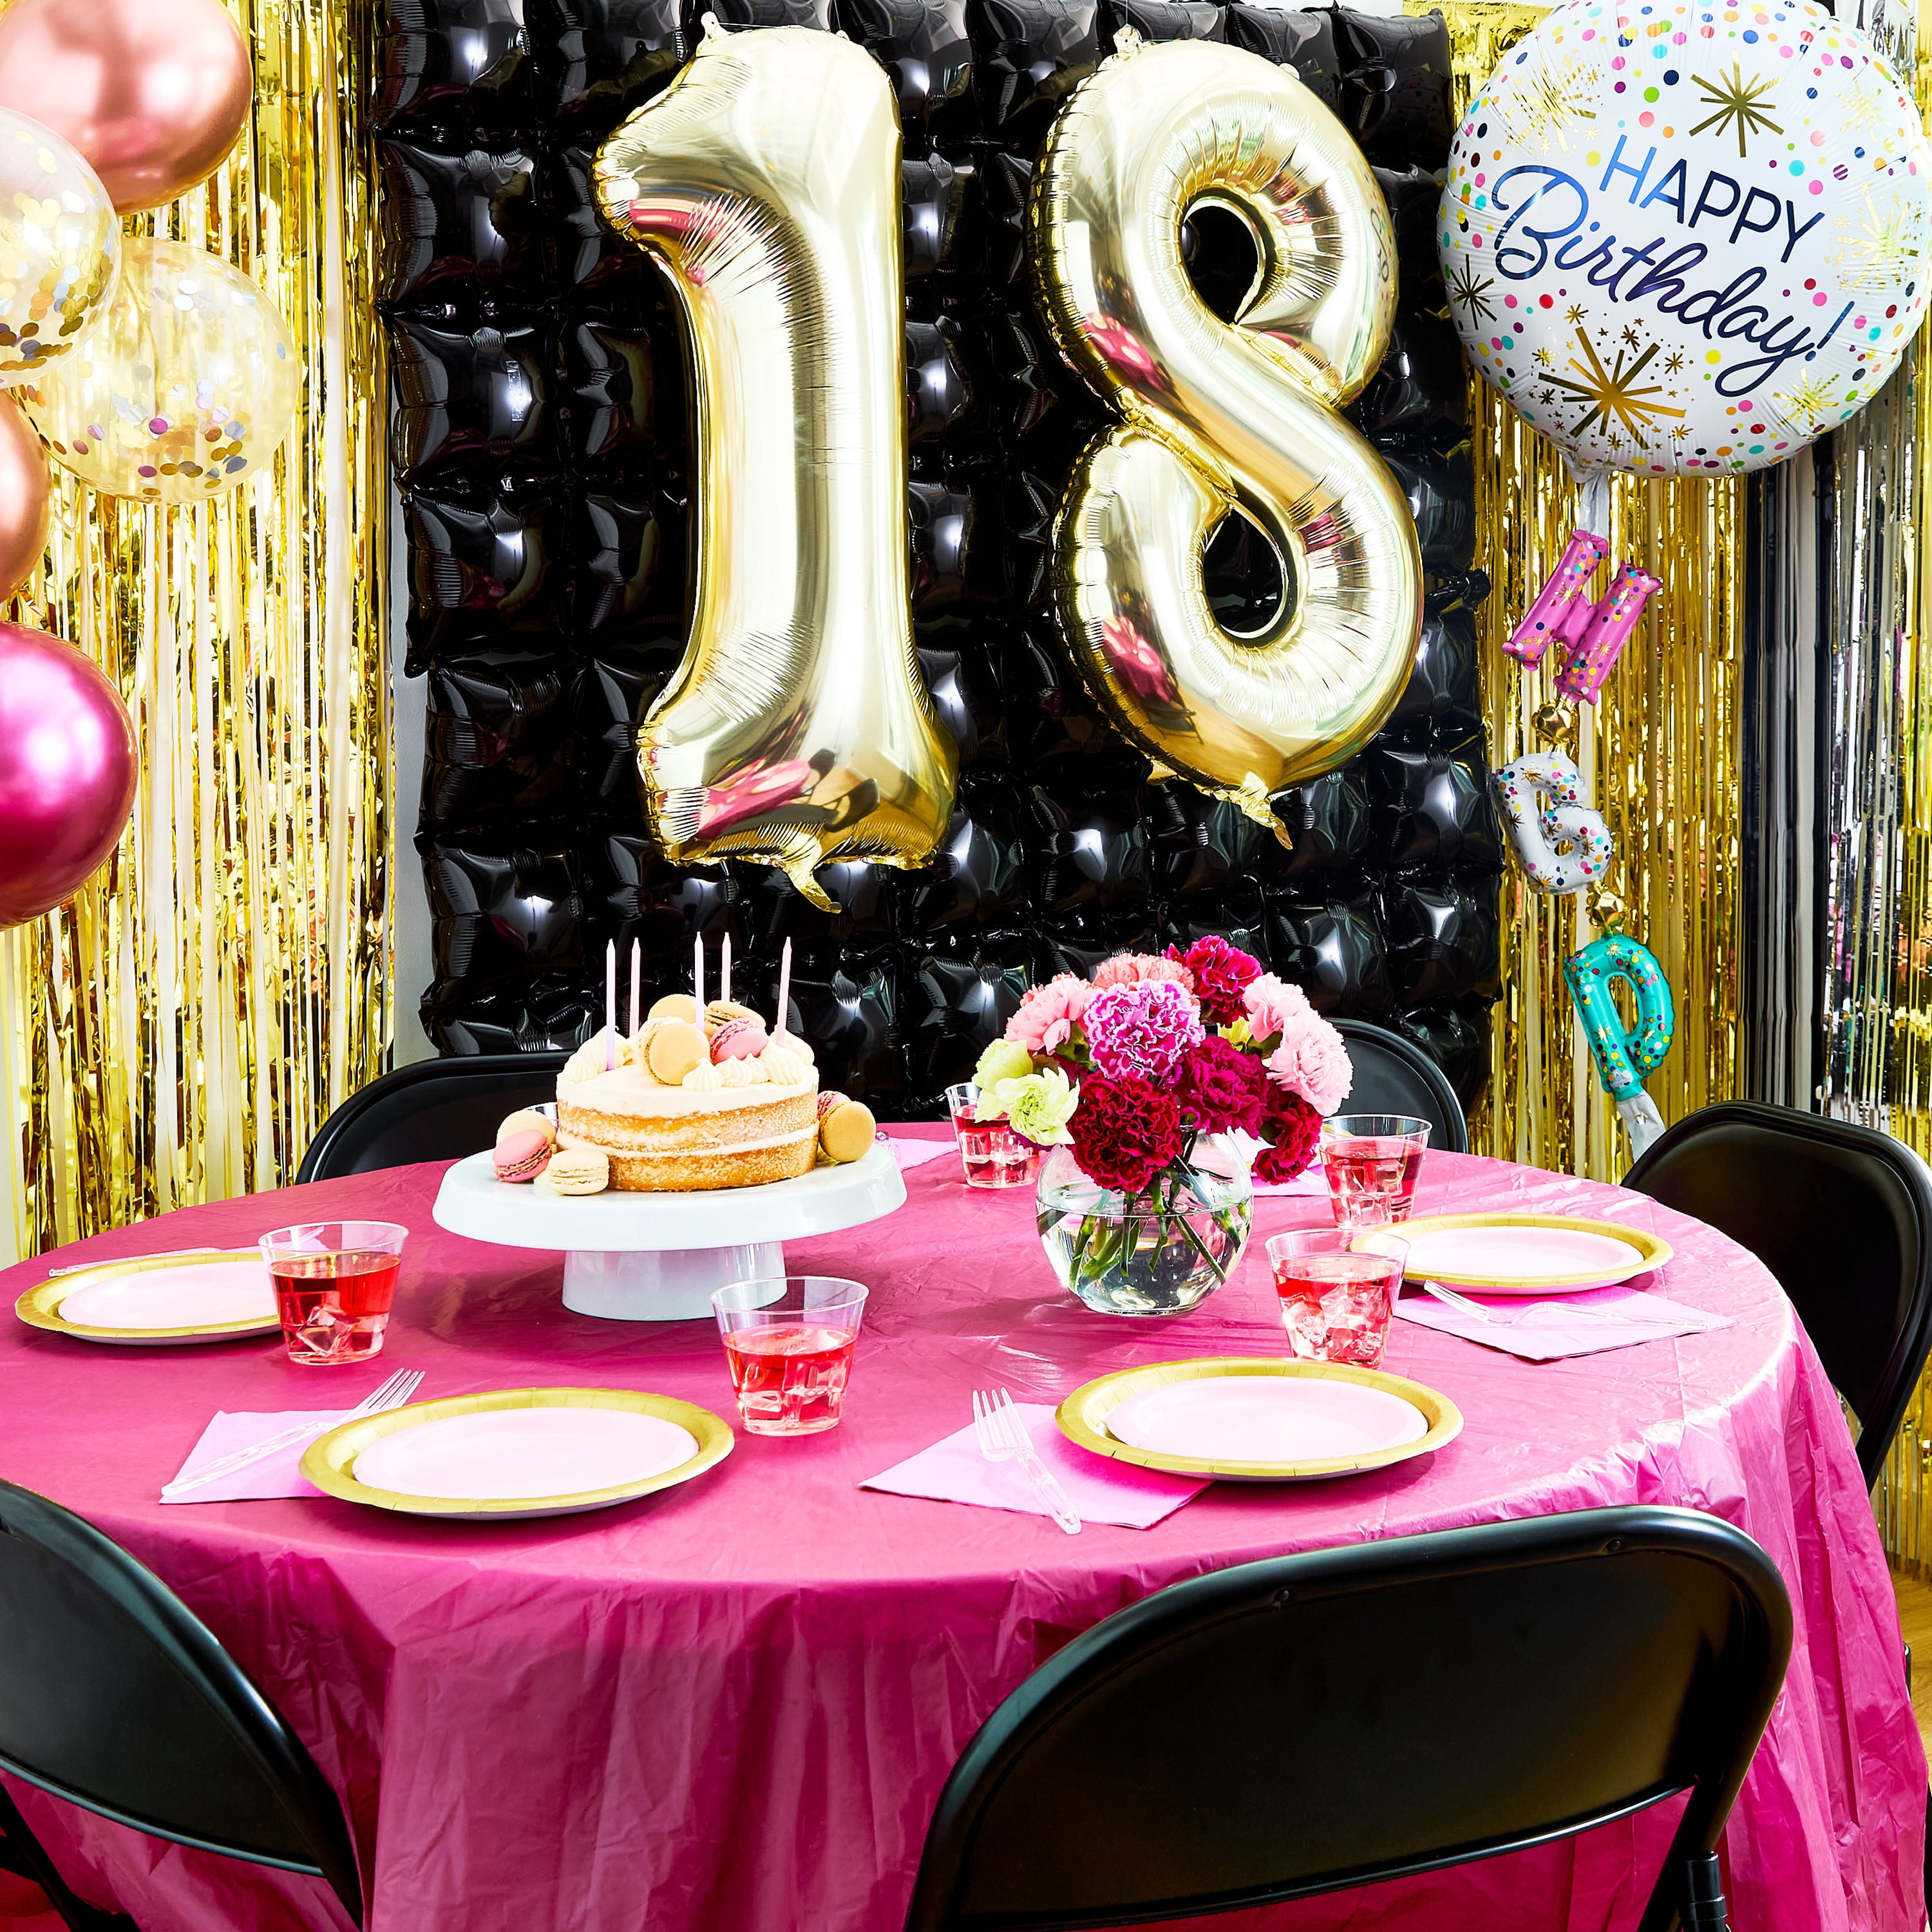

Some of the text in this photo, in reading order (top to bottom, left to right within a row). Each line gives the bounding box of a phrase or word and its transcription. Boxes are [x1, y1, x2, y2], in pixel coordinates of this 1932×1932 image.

[1493, 166, 1855, 397] Birthday!
[1600, 135, 1824, 263] HAPPY
[592, 24, 1424, 868] 18
